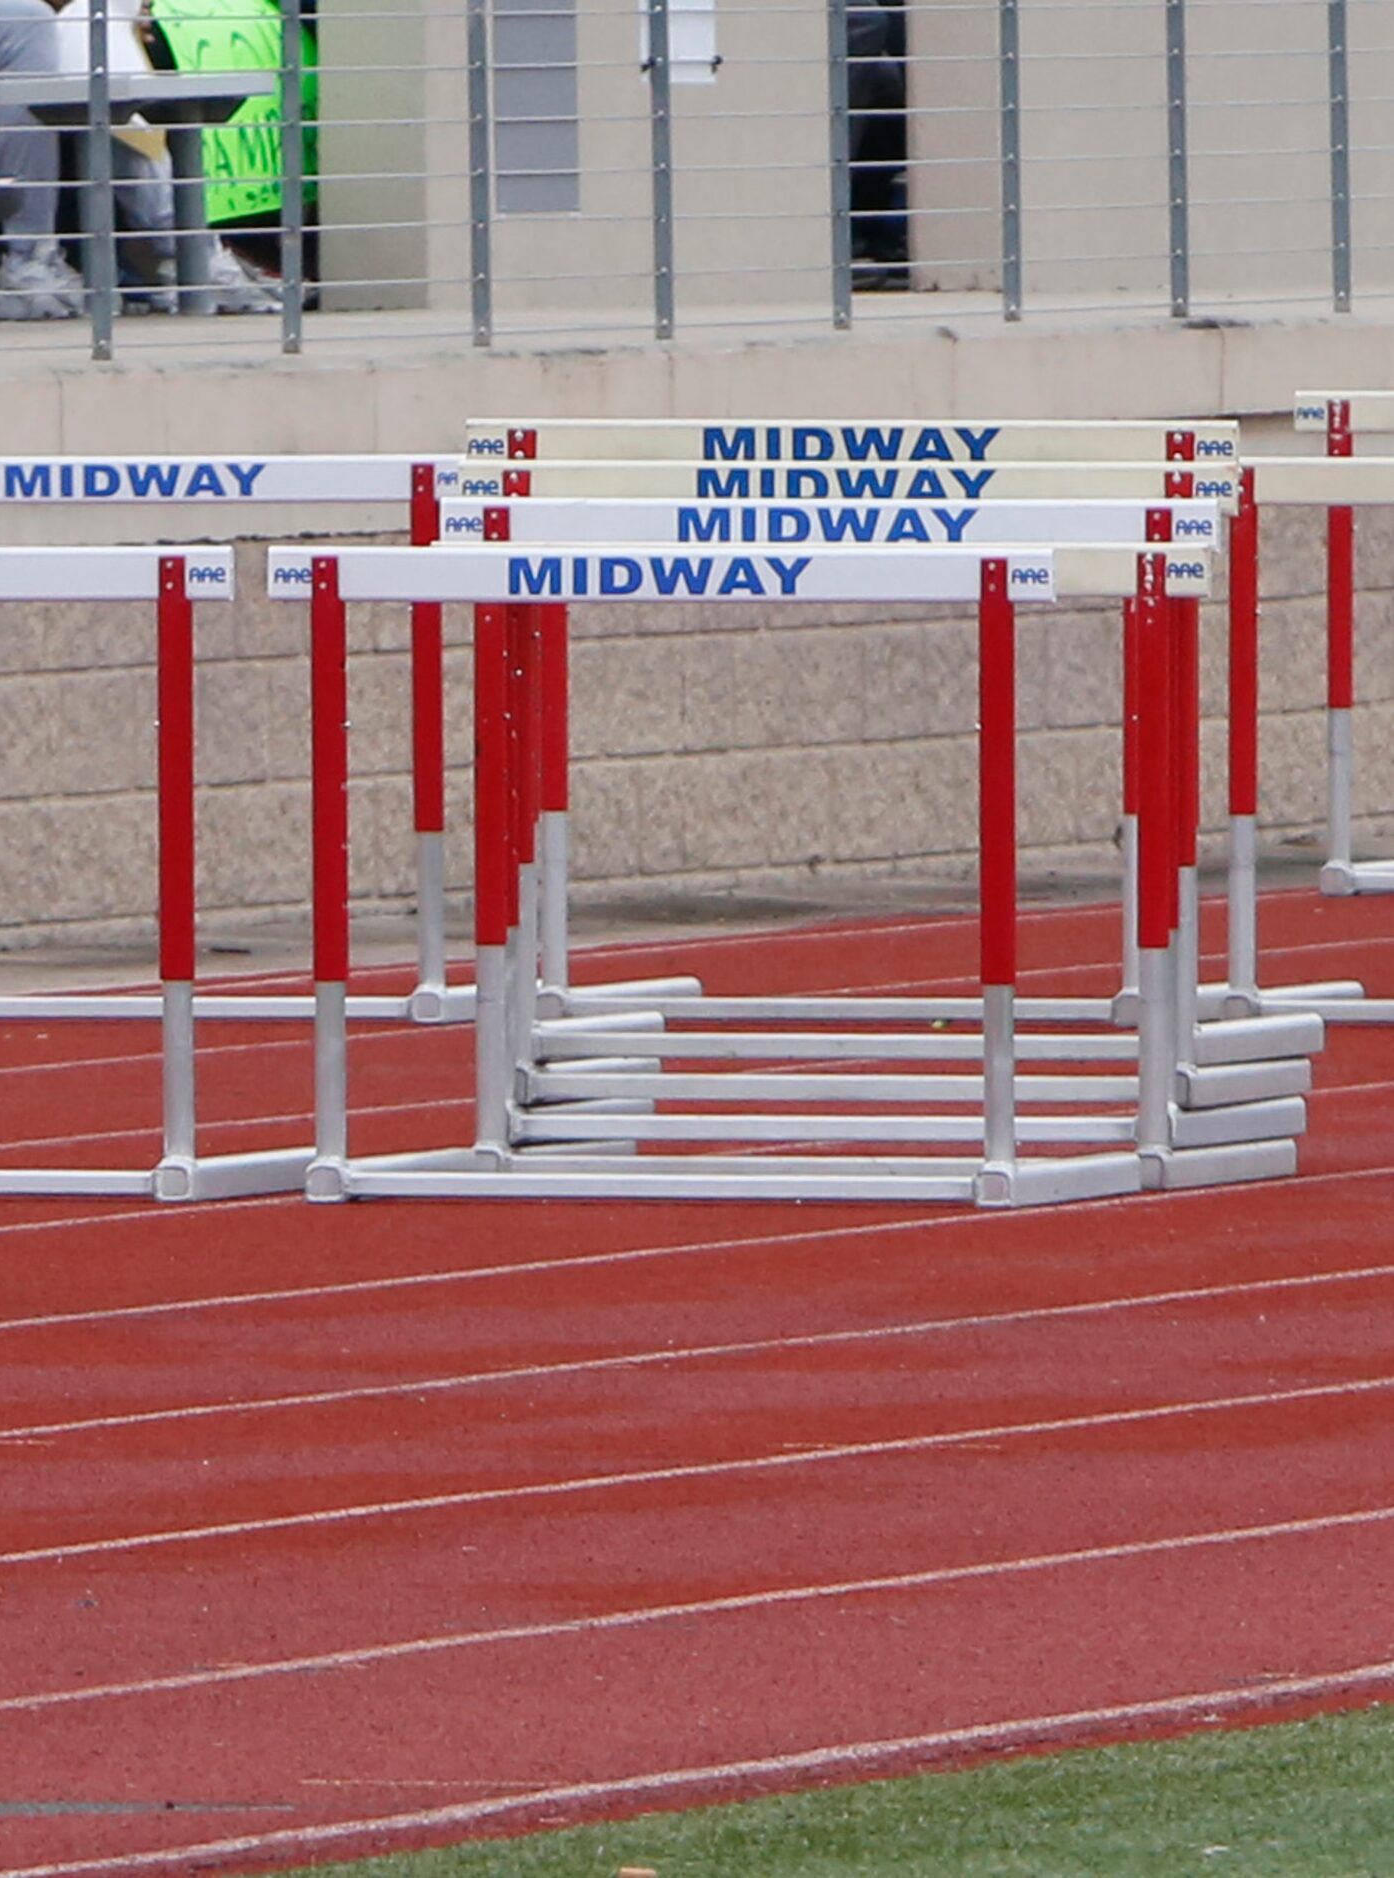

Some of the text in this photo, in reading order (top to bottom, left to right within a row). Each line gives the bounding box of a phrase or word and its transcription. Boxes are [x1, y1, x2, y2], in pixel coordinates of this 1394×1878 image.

[704, 426, 999, 461] MIDWAY
[4, 462, 266, 497] MIDWAY
[697, 466, 995, 499] MIDWAY
[677, 504, 979, 543] MIDWAY
[508, 555, 813, 596] MIDWAY
